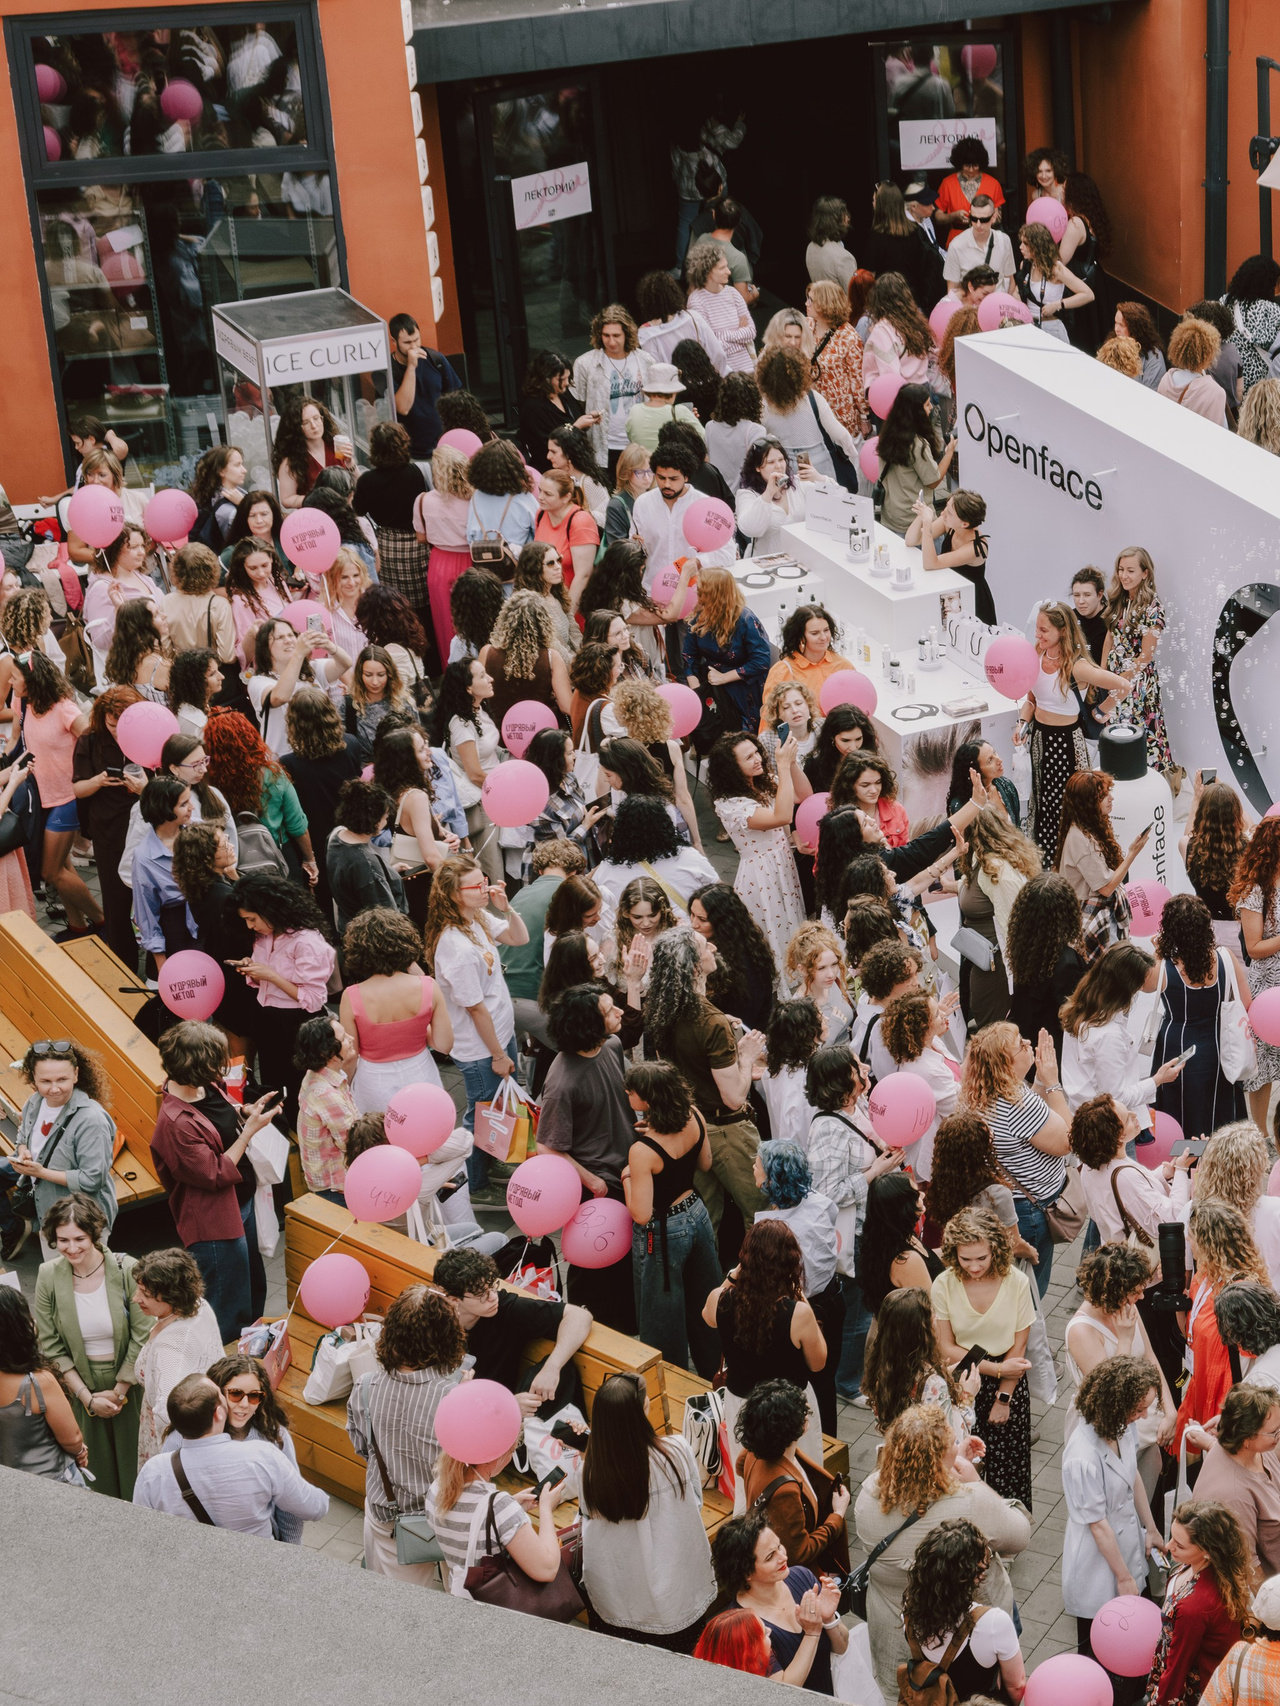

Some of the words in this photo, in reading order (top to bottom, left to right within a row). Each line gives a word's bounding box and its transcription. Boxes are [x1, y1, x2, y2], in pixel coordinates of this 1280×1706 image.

[524, 178, 577, 202] ЛЕКТОРИЙ
[266, 350, 302, 376] ICE
[307, 340, 382, 370] CURLY
[964, 402, 1104, 512] Openface
[704, 518, 721, 531] МЕТОД
[708, 510, 732, 530] КУДРЯВЫЙ
[291, 526, 326, 544] КУДРЯВЫЙ
[295, 540, 317, 552] МЕТОД
[1125, 889, 1143, 909] МЕТОД
[1133, 885, 1158, 917] КУДРЯВЫЙ
[168, 975, 208, 993] КУДРЯВЫЙ
[171, 988, 196, 1001] МЕТОД
